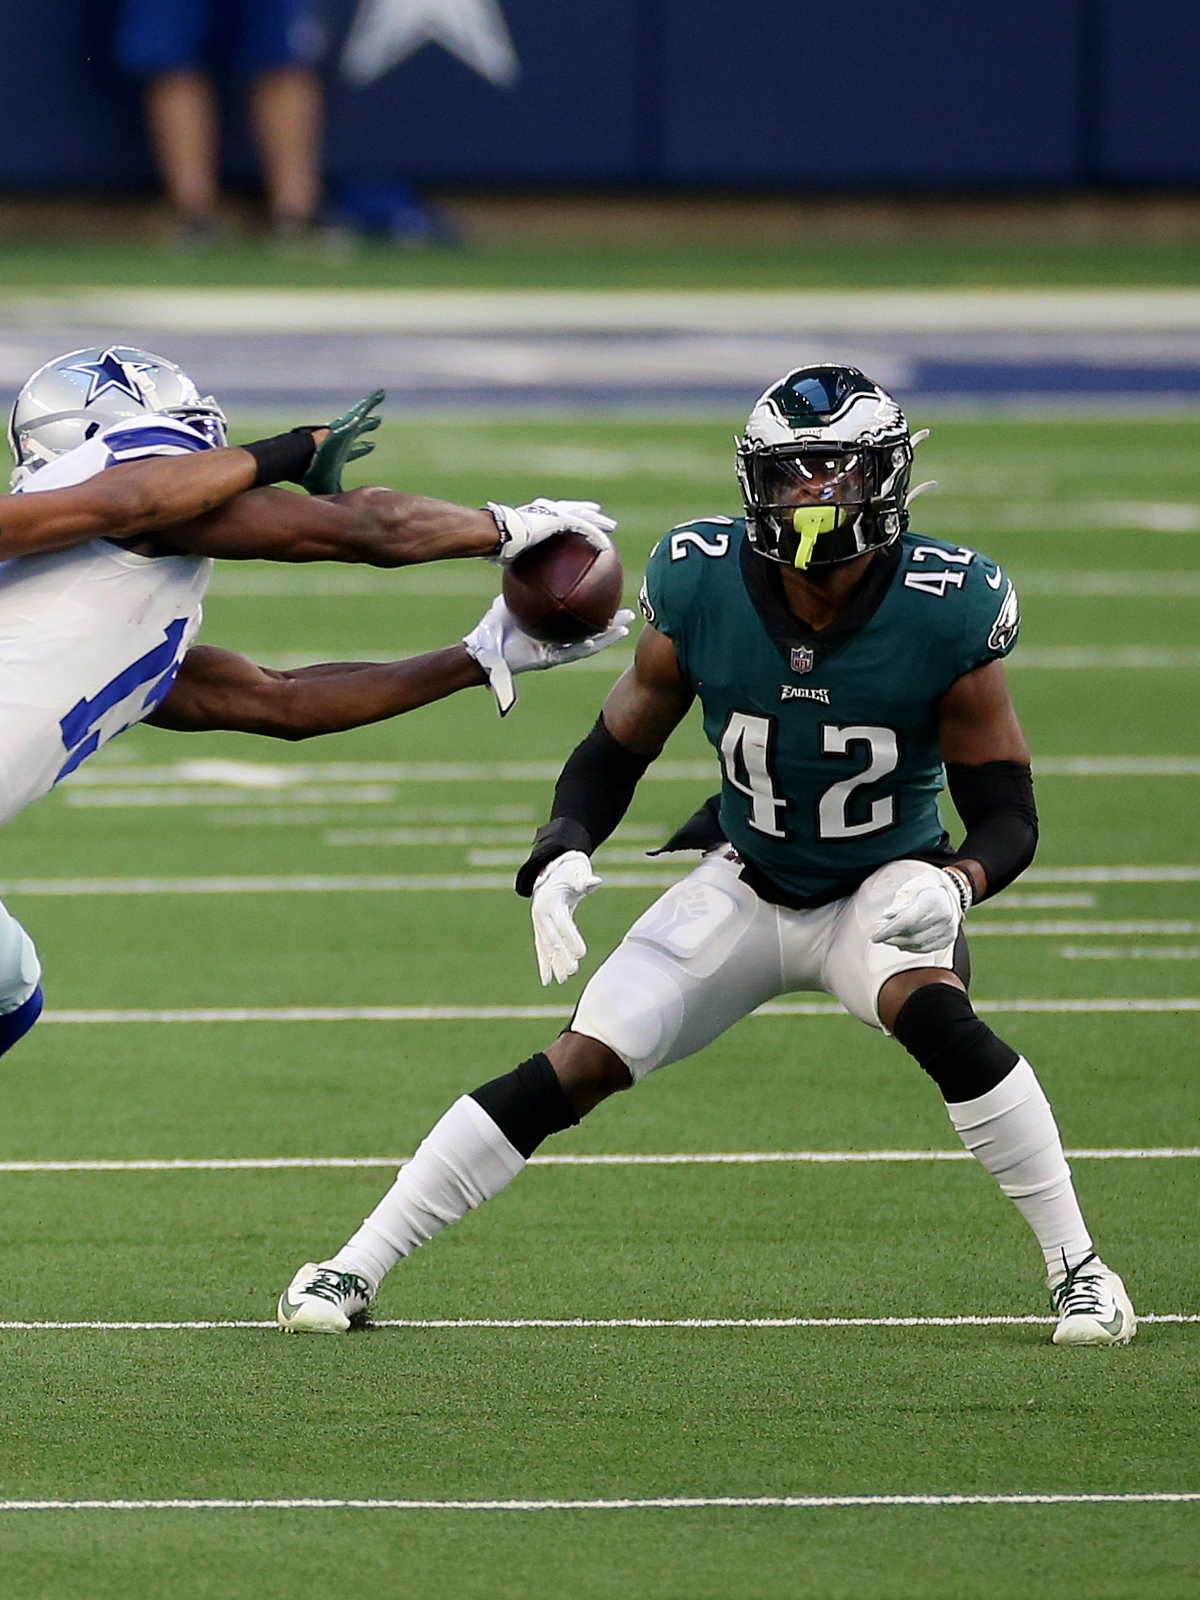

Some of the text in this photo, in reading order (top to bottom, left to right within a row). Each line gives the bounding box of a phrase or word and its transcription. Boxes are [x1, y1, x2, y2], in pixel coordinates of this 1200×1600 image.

[670, 514, 734, 561] 2
[904, 545, 974, 597] 42
[793, 658, 811, 670] NFL
[780, 684, 831, 706] EAGLES
[720, 711, 899, 839] 42
